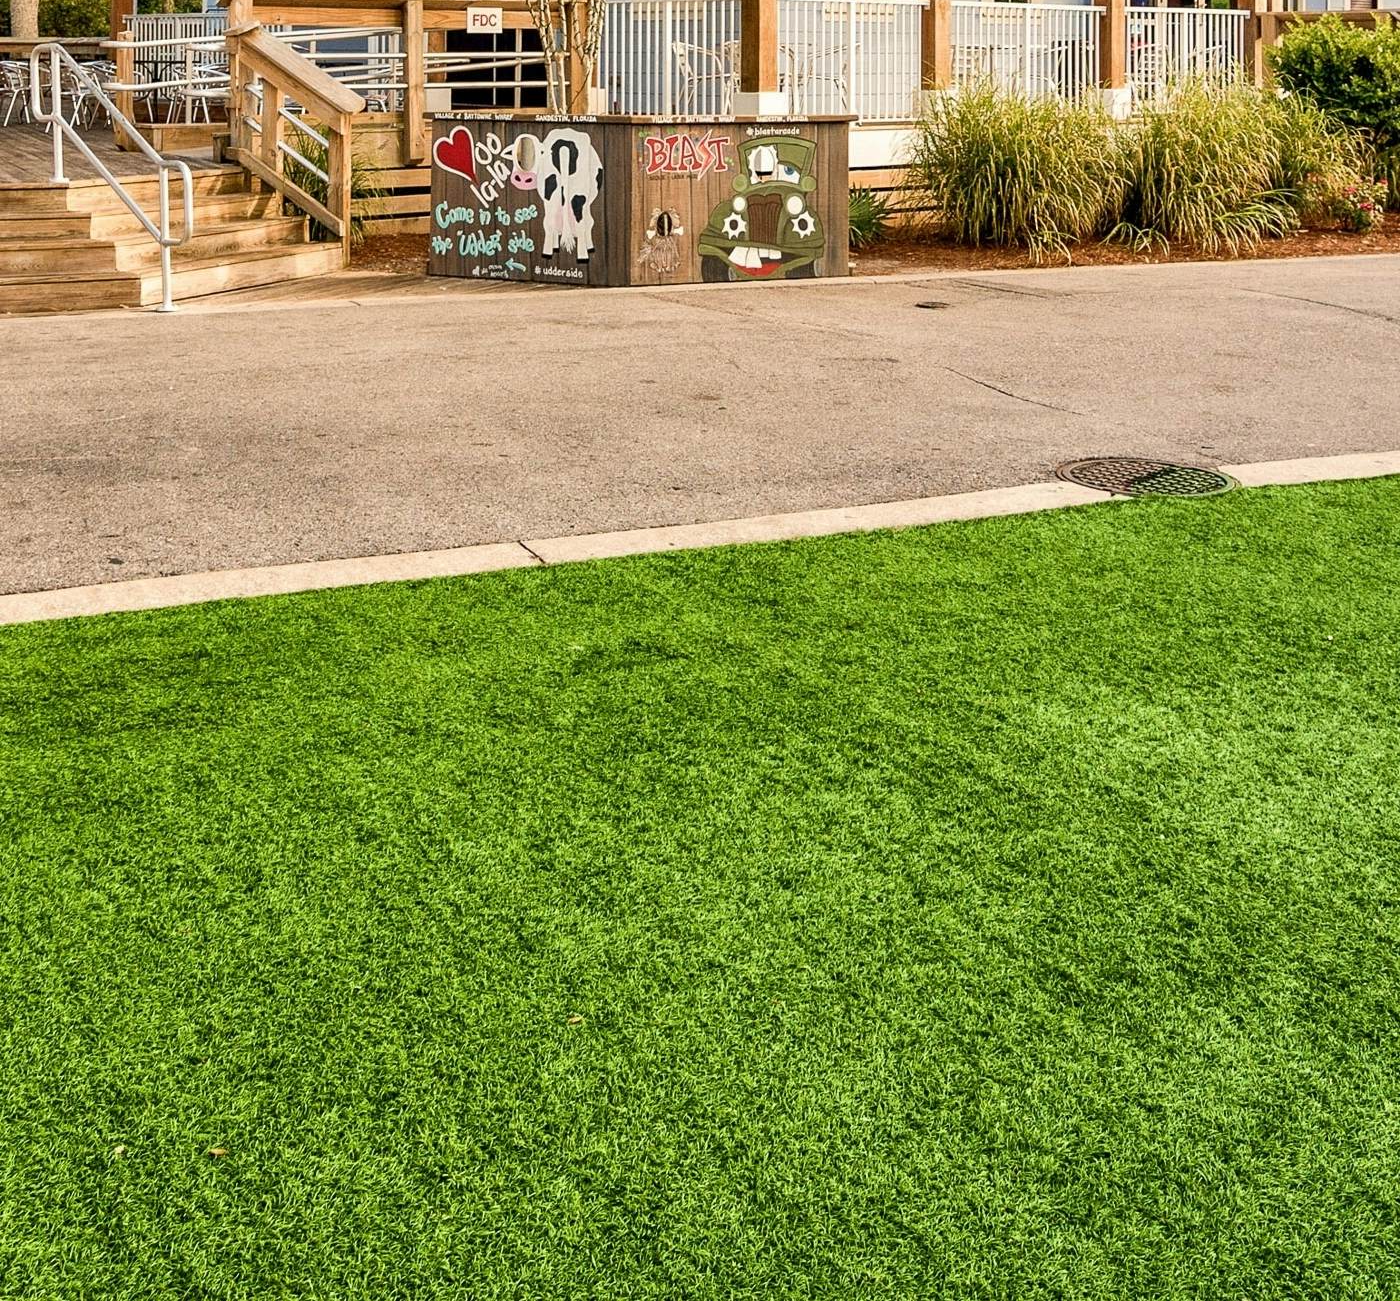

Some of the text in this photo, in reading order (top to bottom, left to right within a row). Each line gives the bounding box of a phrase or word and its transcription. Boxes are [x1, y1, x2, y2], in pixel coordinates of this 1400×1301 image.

[472, 14, 497, 27] FDC
[645, 129, 730, 181] BLAST
[435, 201, 474, 228] Come
[514, 204, 538, 224] see
[432, 235, 454, 256] the
[508, 230, 535, 254] side
